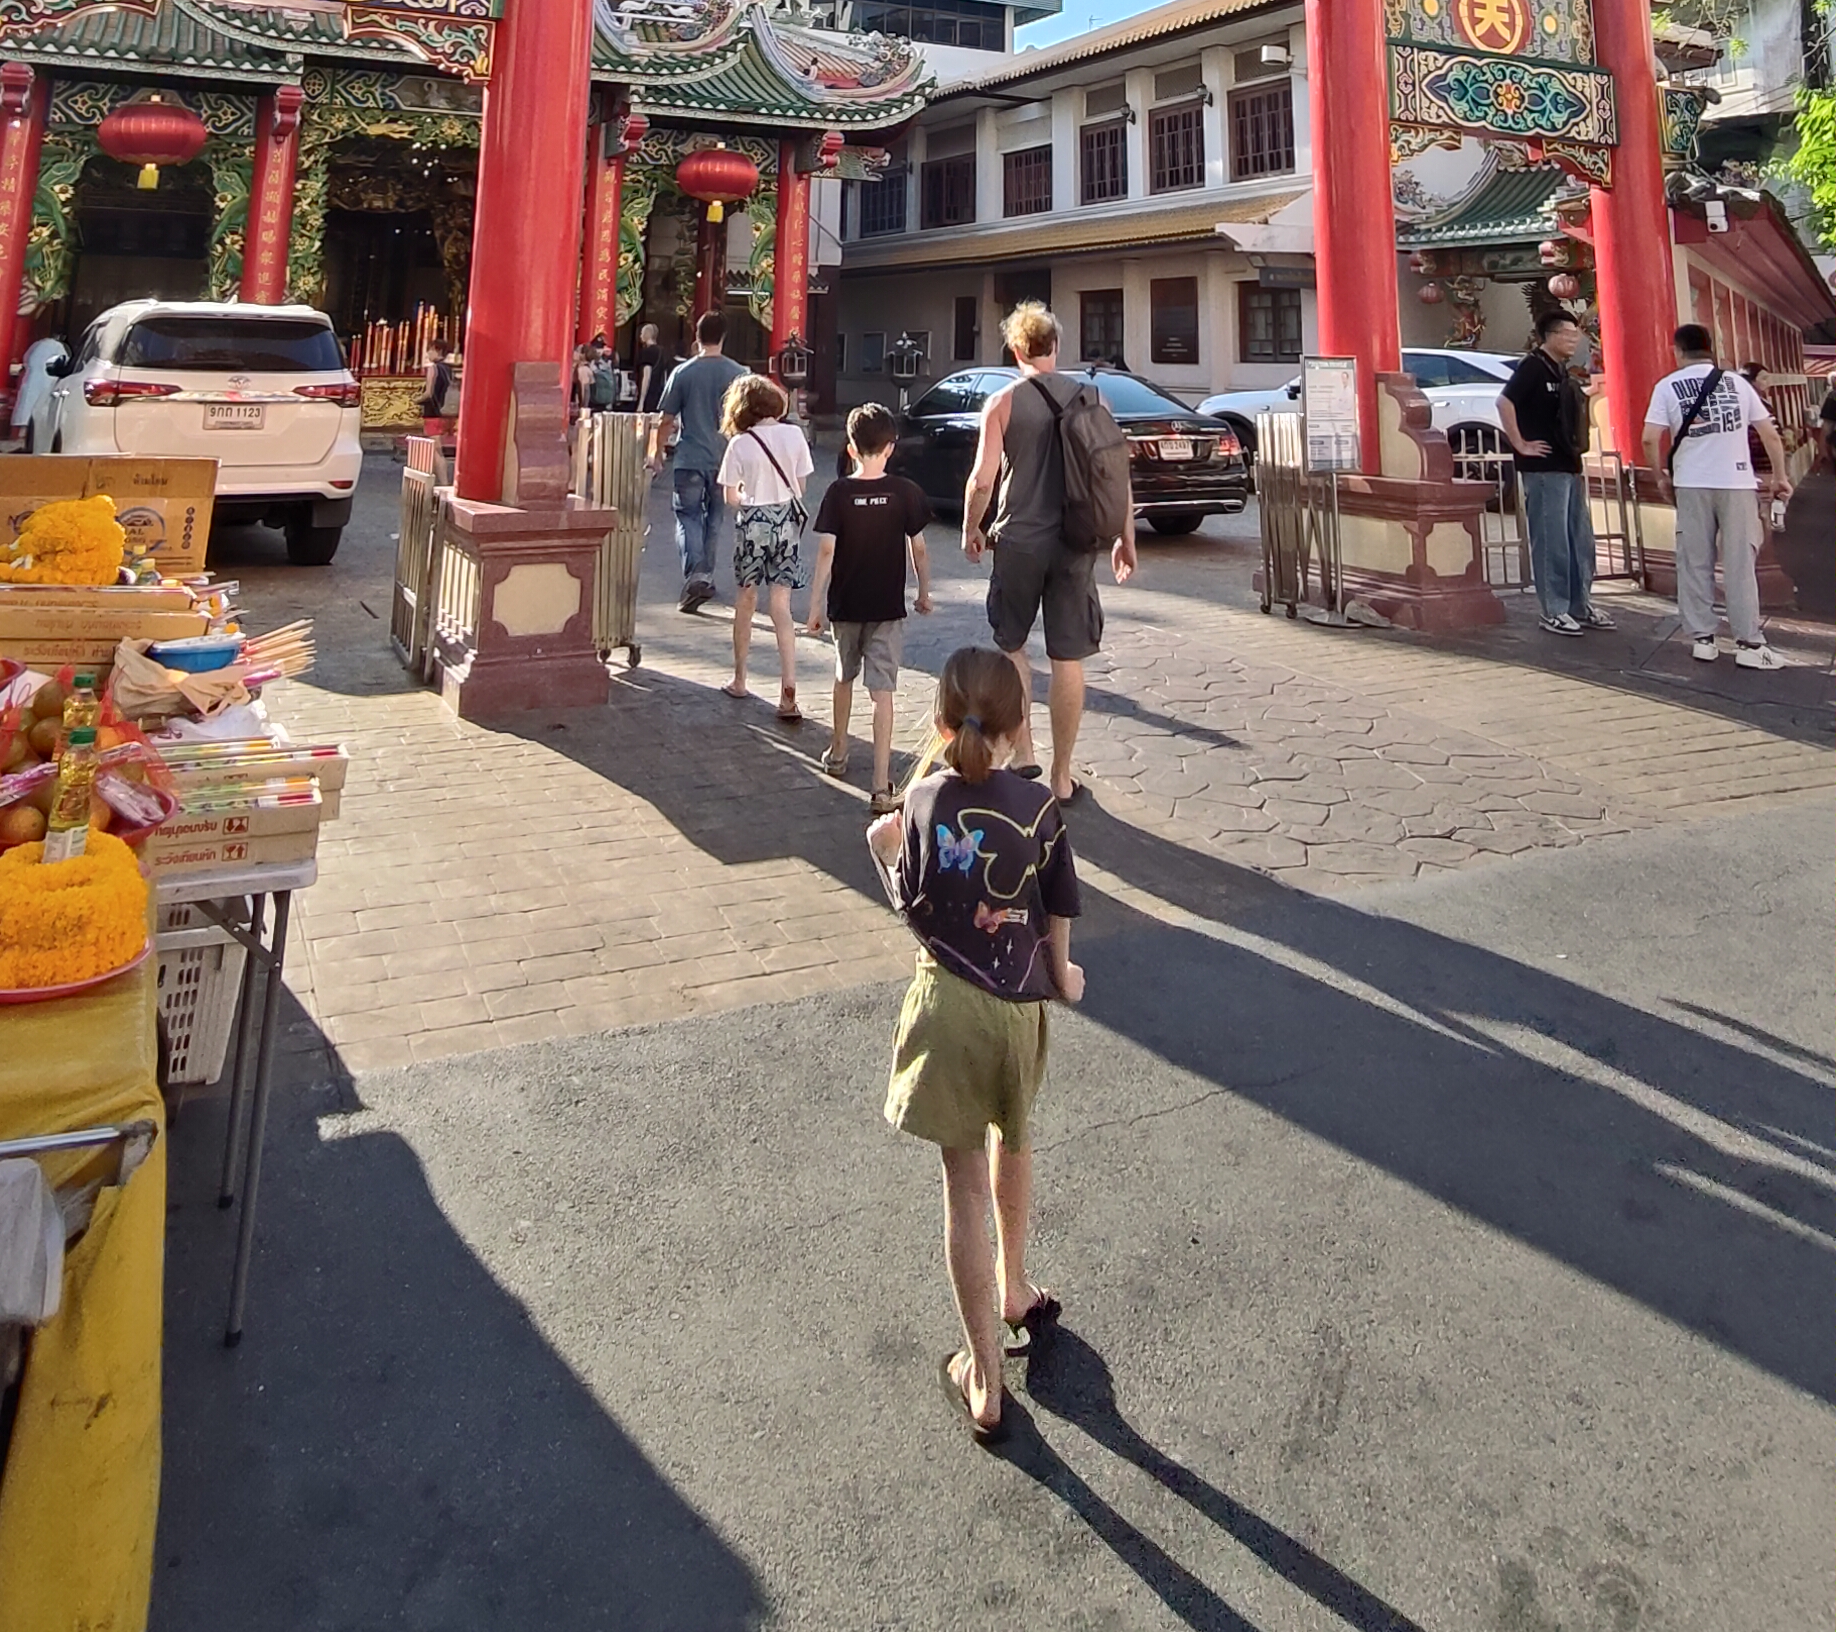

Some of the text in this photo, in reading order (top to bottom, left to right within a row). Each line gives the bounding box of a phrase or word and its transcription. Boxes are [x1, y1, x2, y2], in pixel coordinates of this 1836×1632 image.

[236, 407, 261, 418] 1123
[154, 848, 217, 866] ระวังเทียนหัก
